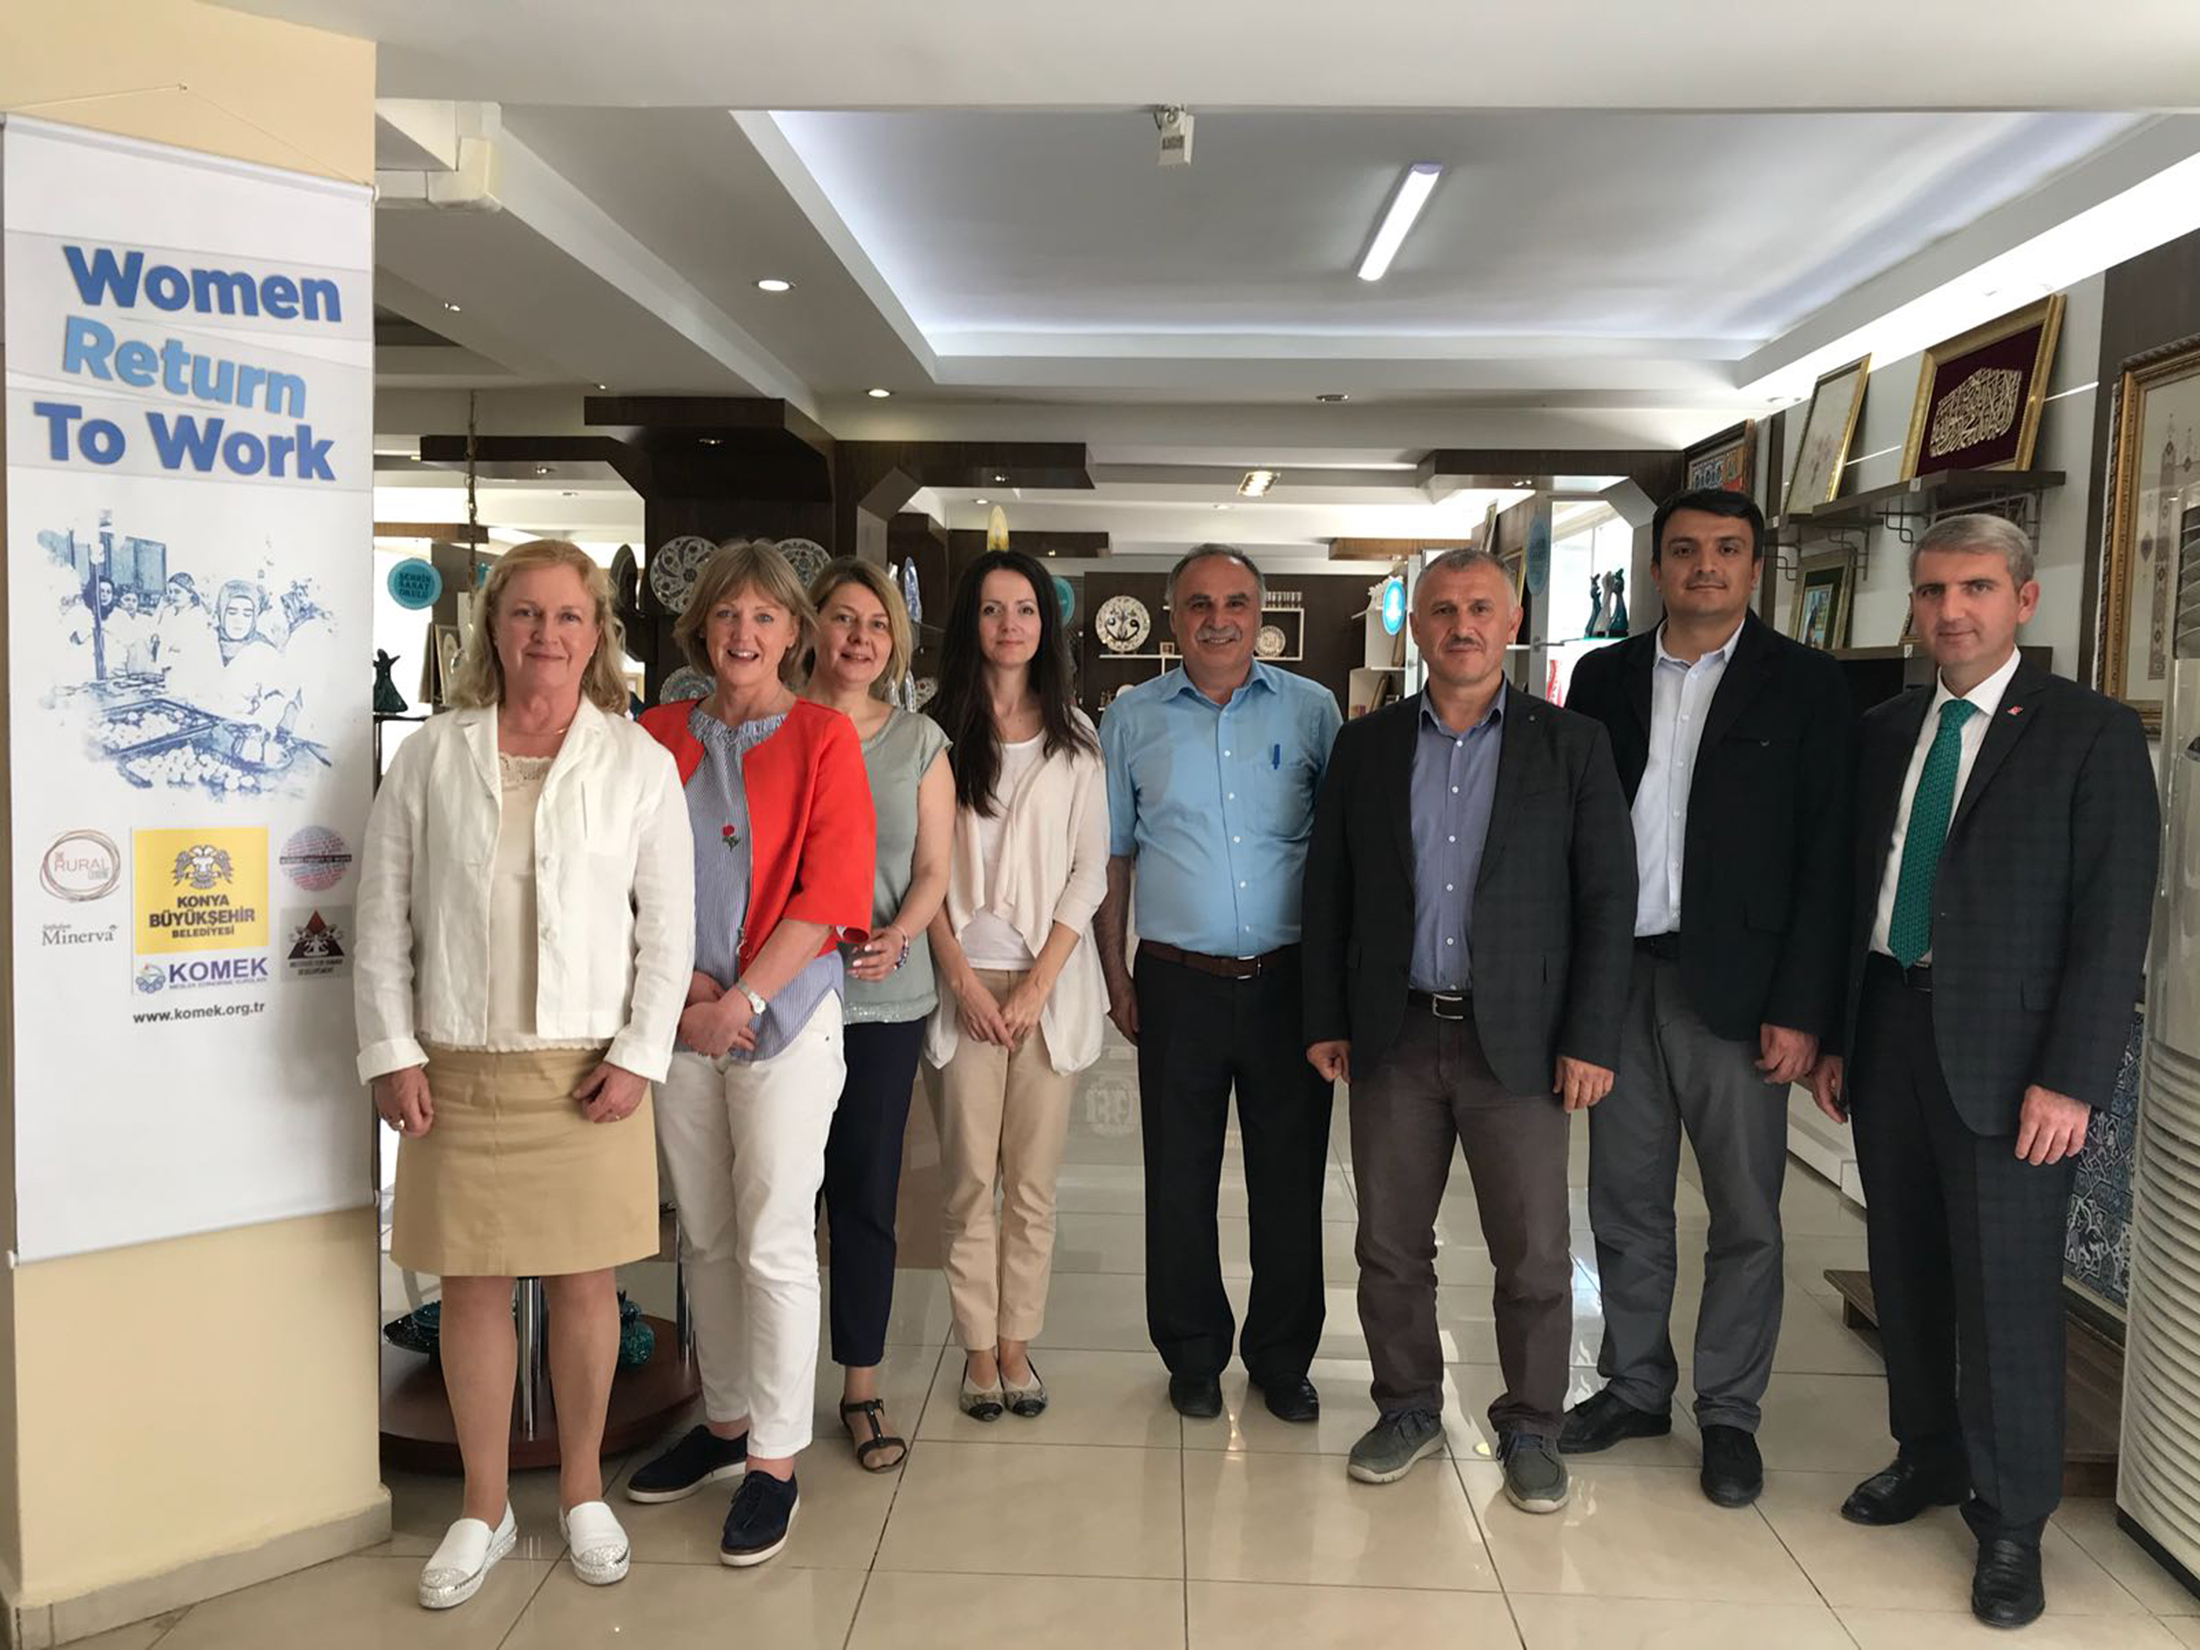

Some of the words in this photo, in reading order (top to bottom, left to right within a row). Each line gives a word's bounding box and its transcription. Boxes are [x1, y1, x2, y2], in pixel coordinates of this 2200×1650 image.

[63, 245, 341, 322] Women
[63, 315, 306, 418] Return
[33, 401, 126, 465] To
[145, 411, 336, 481] Work
[54, 857, 106, 872] RURAL
[176, 894, 230, 908] KONYA
[149, 907, 255, 928] BÜYÜKŞEHİR
[42, 928, 114, 945] Minerva
[171, 926, 235, 938] BELEDİYESİ
[169, 957, 269, 983] KOMEK
[133, 1002, 266, 1023] www.komek.org.tr
